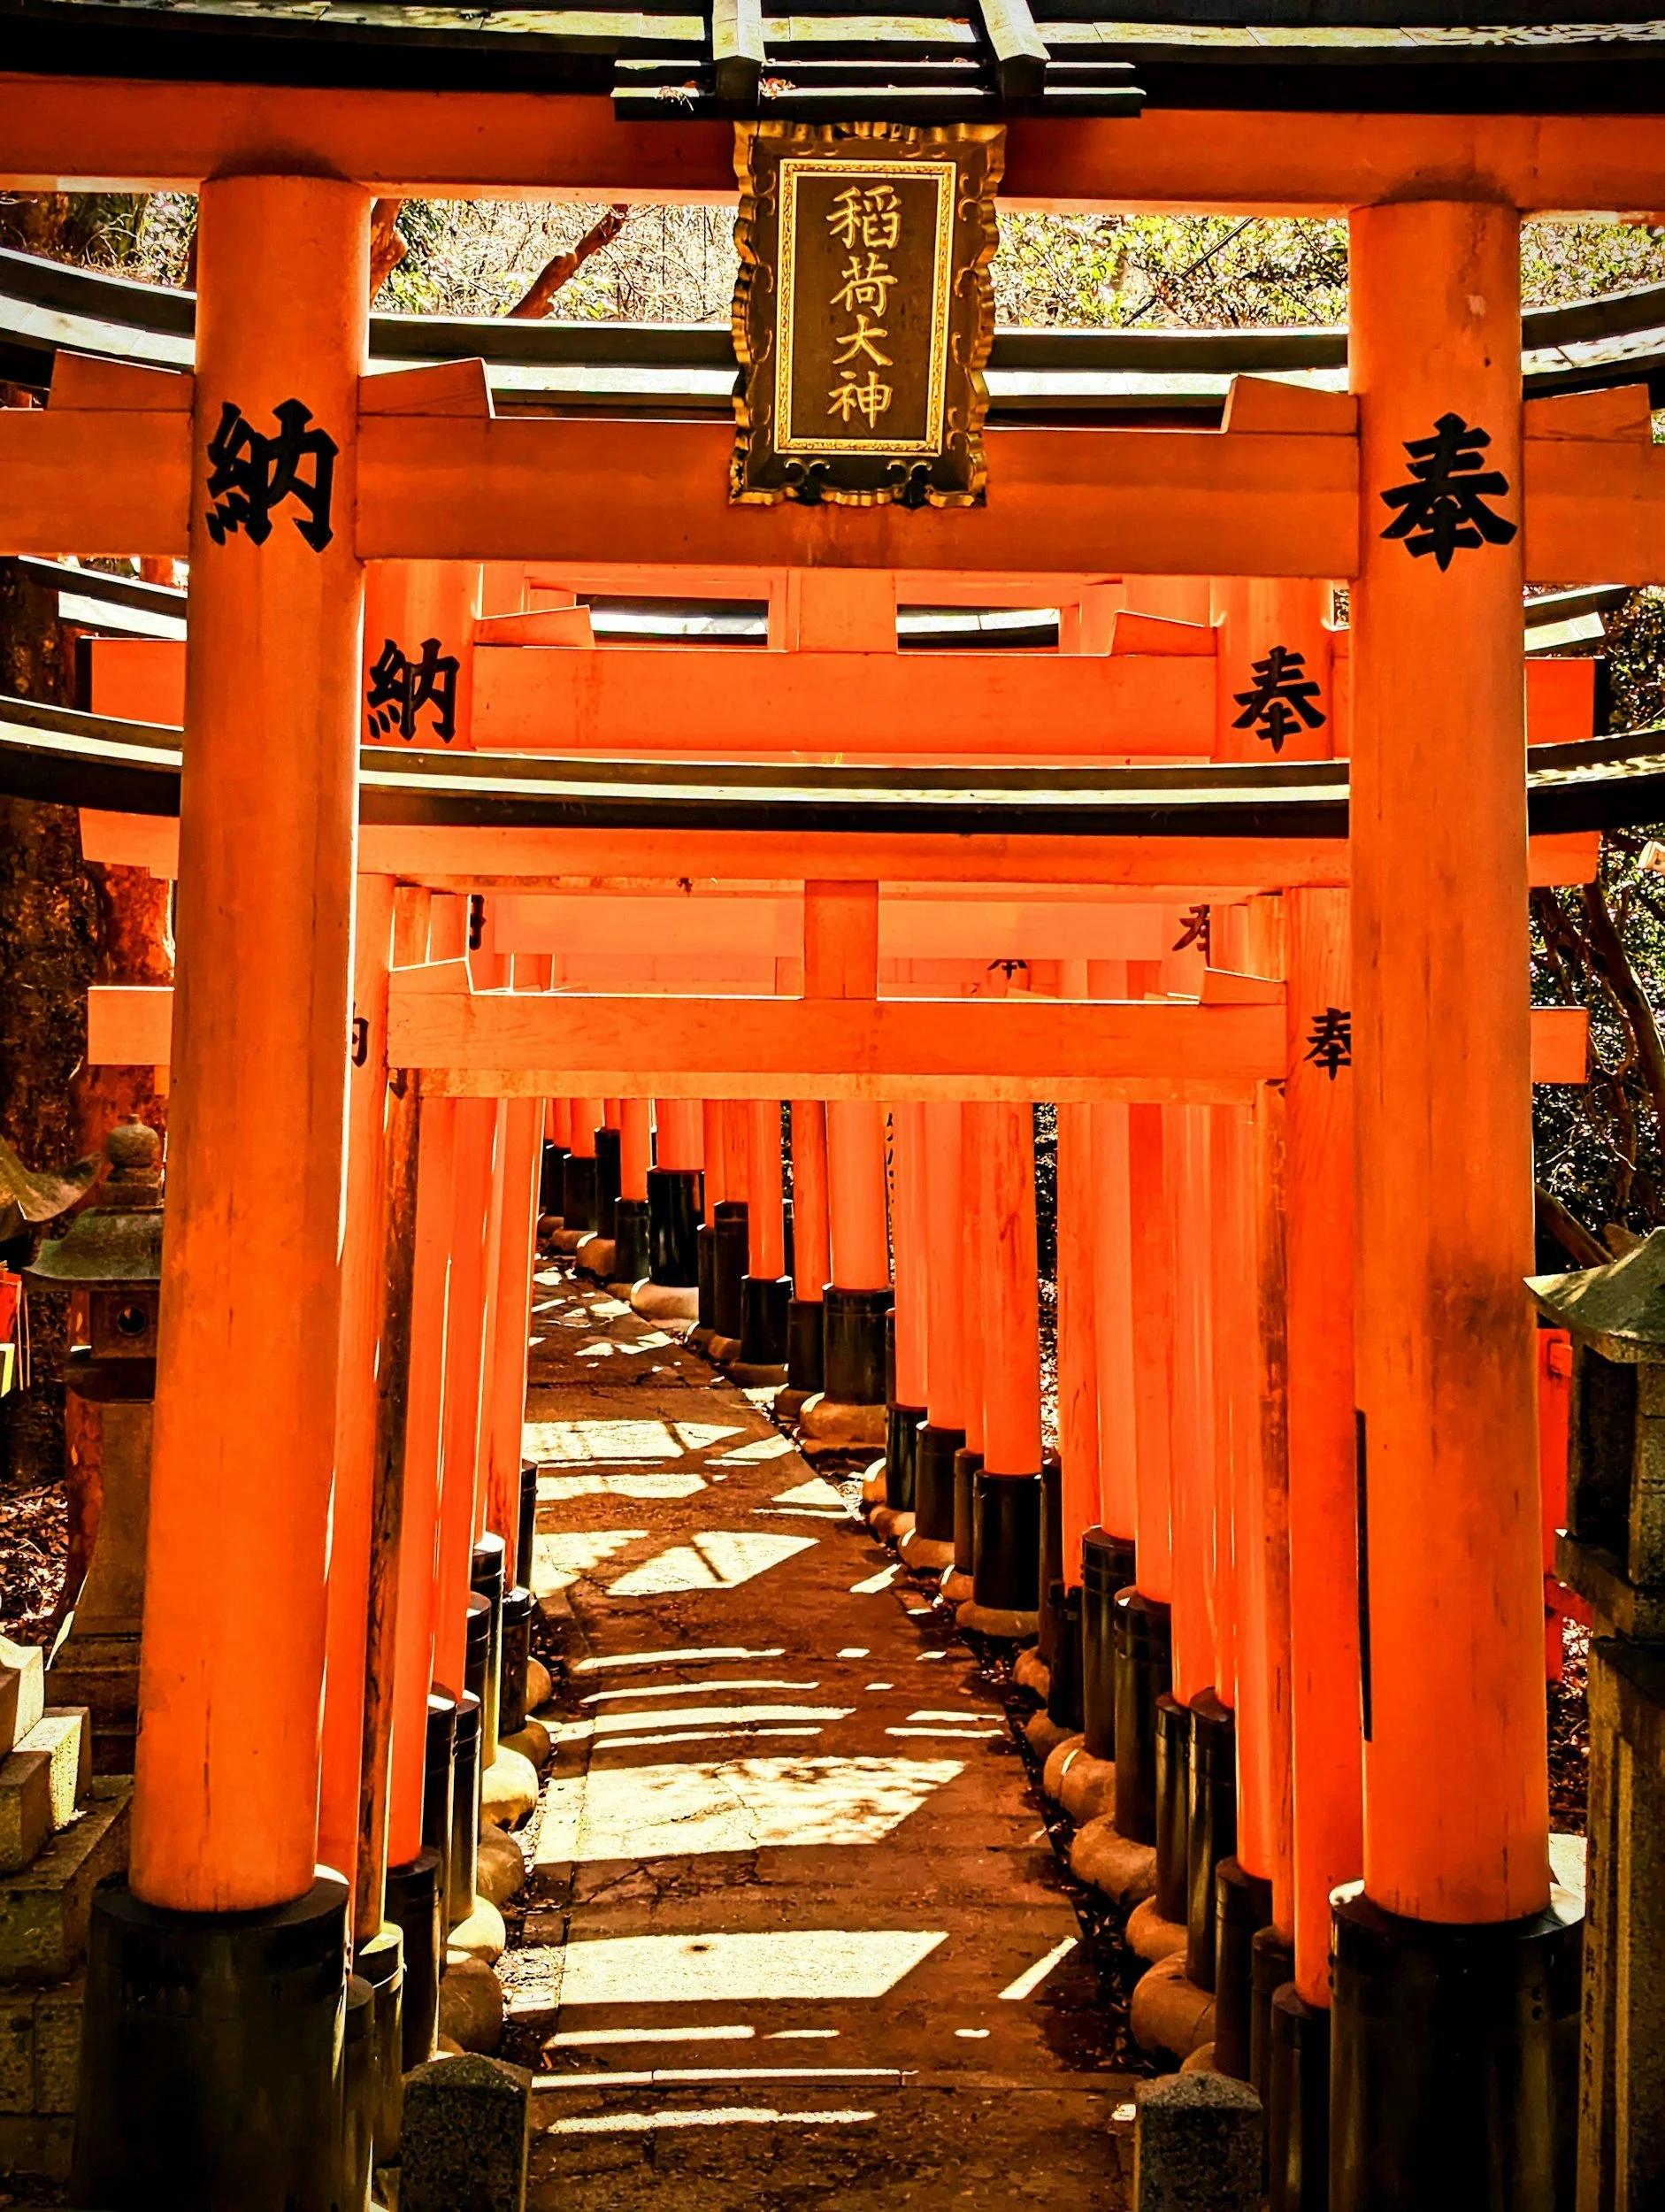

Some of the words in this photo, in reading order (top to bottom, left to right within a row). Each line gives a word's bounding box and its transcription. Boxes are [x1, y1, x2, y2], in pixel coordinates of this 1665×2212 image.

[825, 185, 902, 429] 稲荷大神
[205, 398, 340, 553] 納
[1379, 412, 1518, 572] 奉
[367, 638, 460, 743] 納
[1231, 646, 1327, 754] 奉
[1303, 1007, 1352, 1081] 奉
